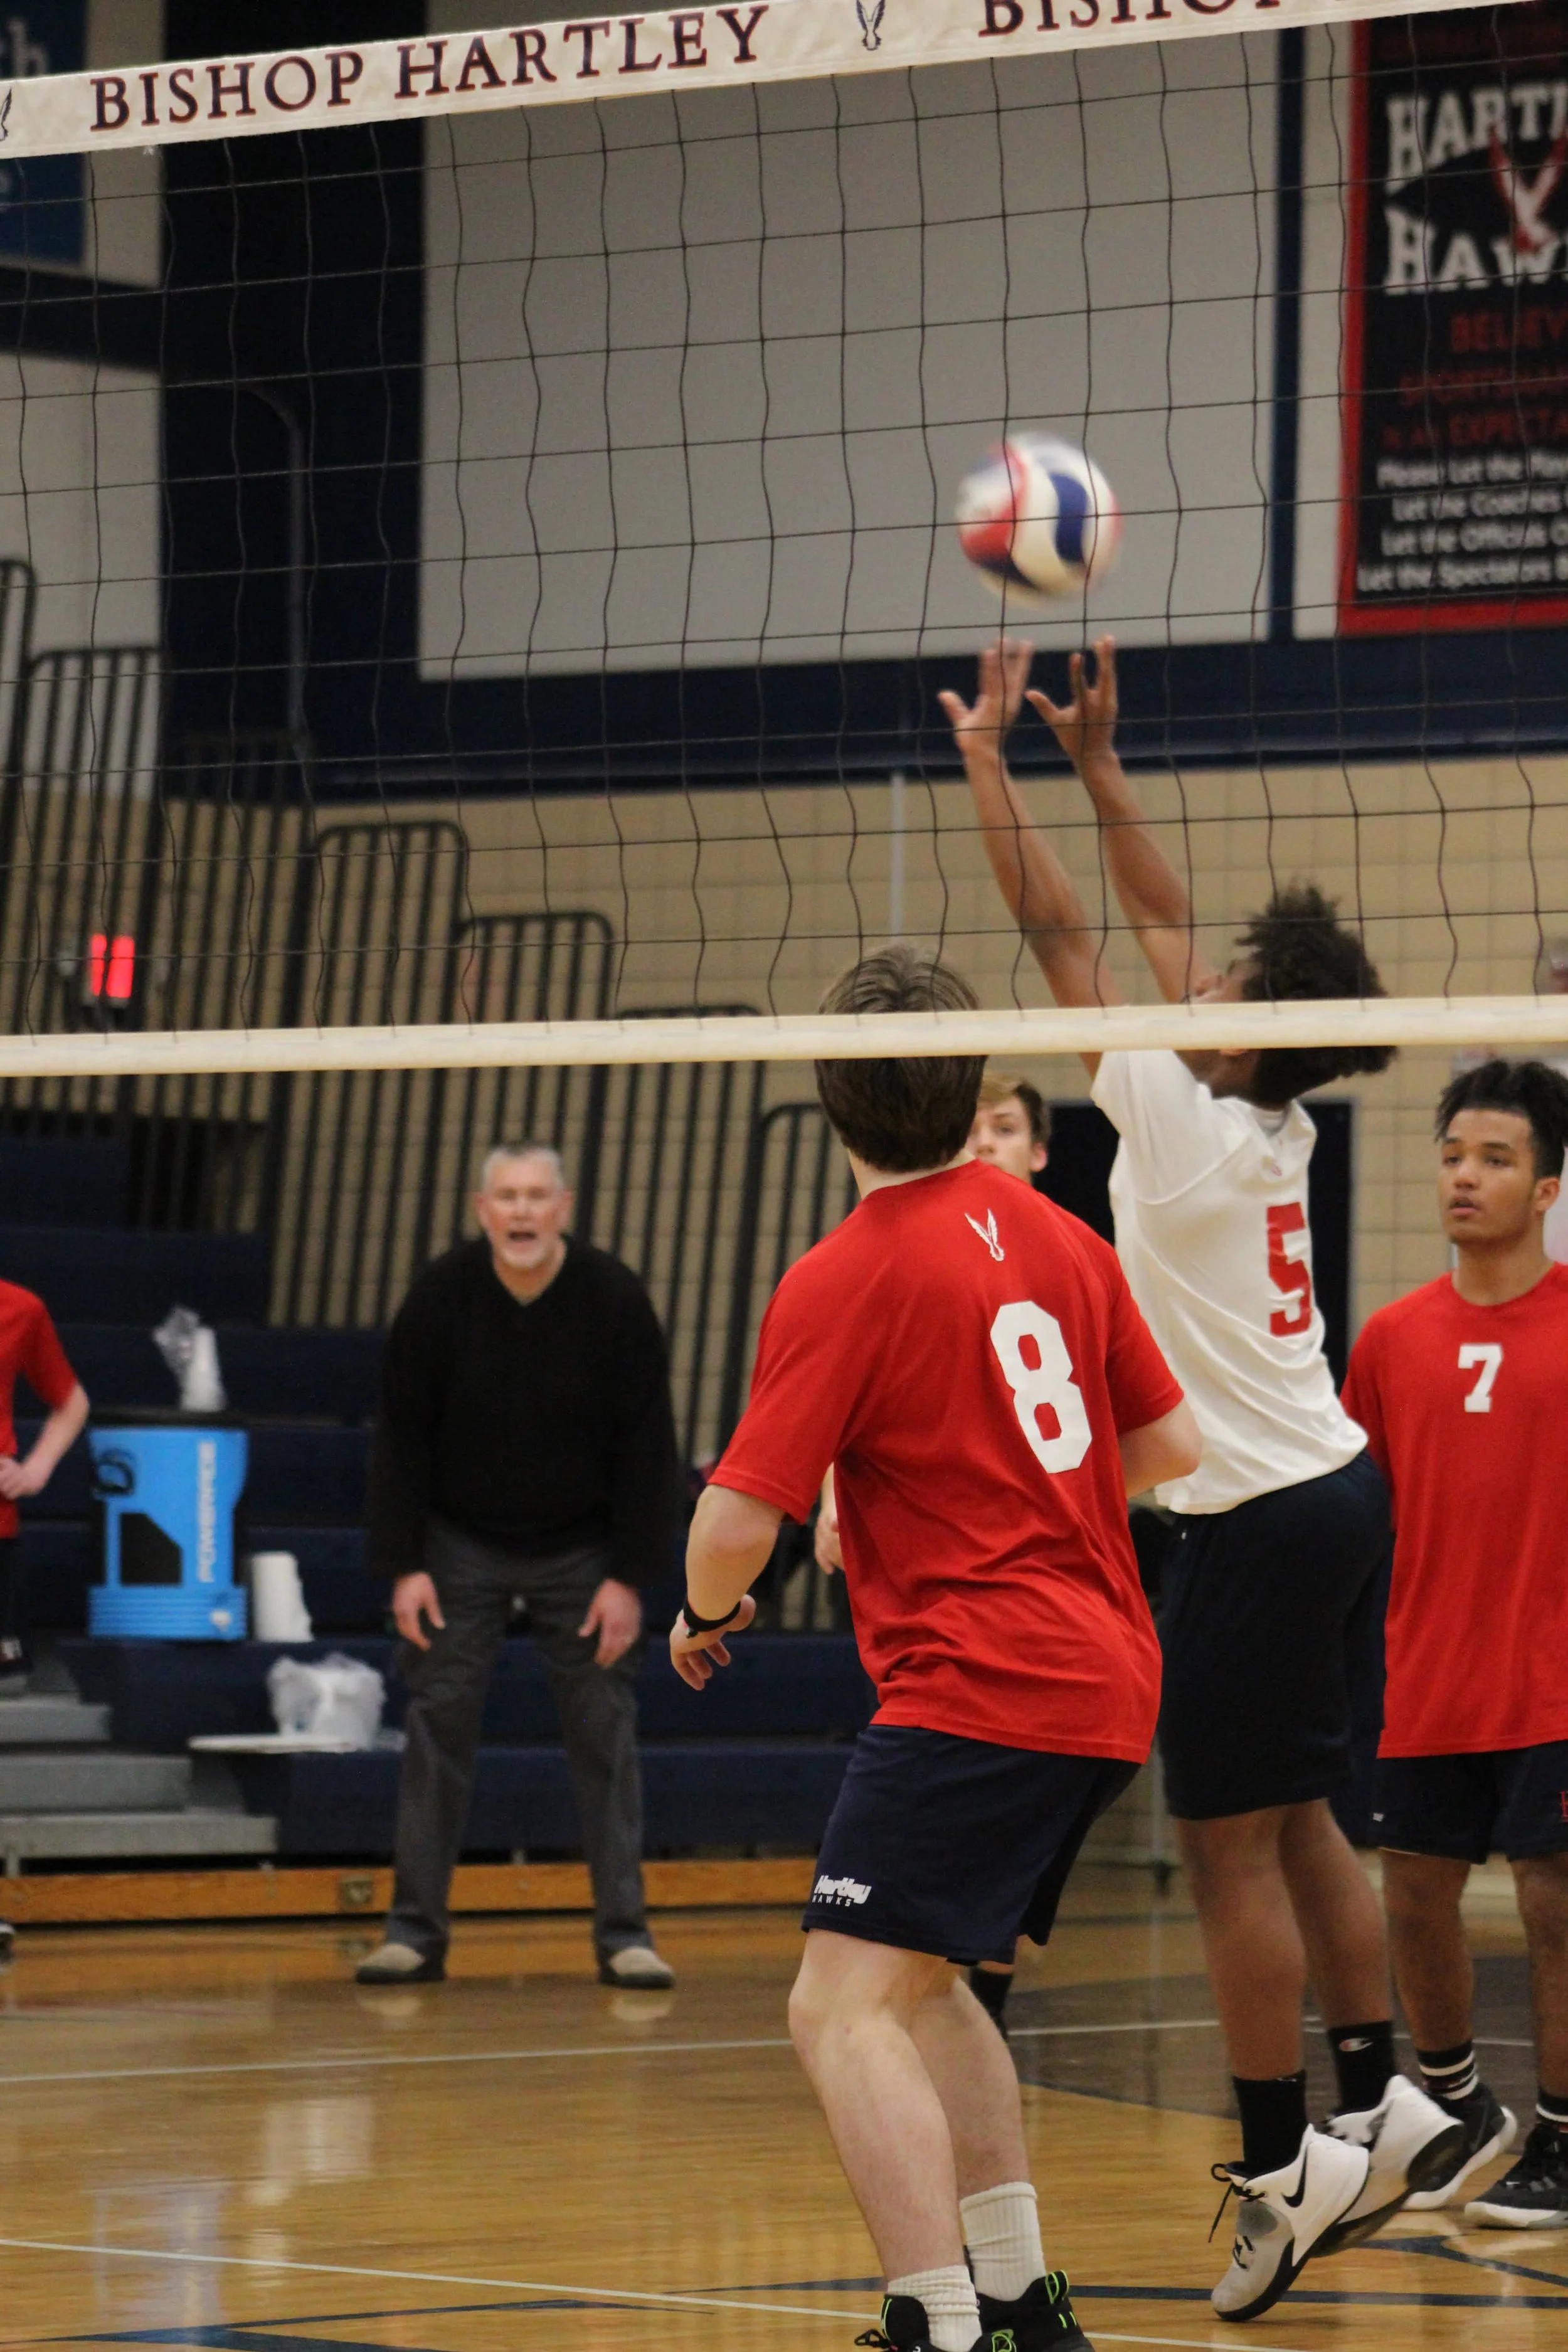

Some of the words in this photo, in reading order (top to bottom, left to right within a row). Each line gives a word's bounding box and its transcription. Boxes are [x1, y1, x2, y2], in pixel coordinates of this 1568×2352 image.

[978, 0, 1279, 37] BIS
[90, 50, 365, 131] BISHOP
[395, 7, 770, 99] HARTLEY
[1384, 206, 1568, 295] HAW
[1266, 1201, 1312, 1337] 5
[990, 1300, 1092, 1473] 8
[1458, 1342, 1503, 1412] 7
[812, 1894, 852, 1907] HAWKS
